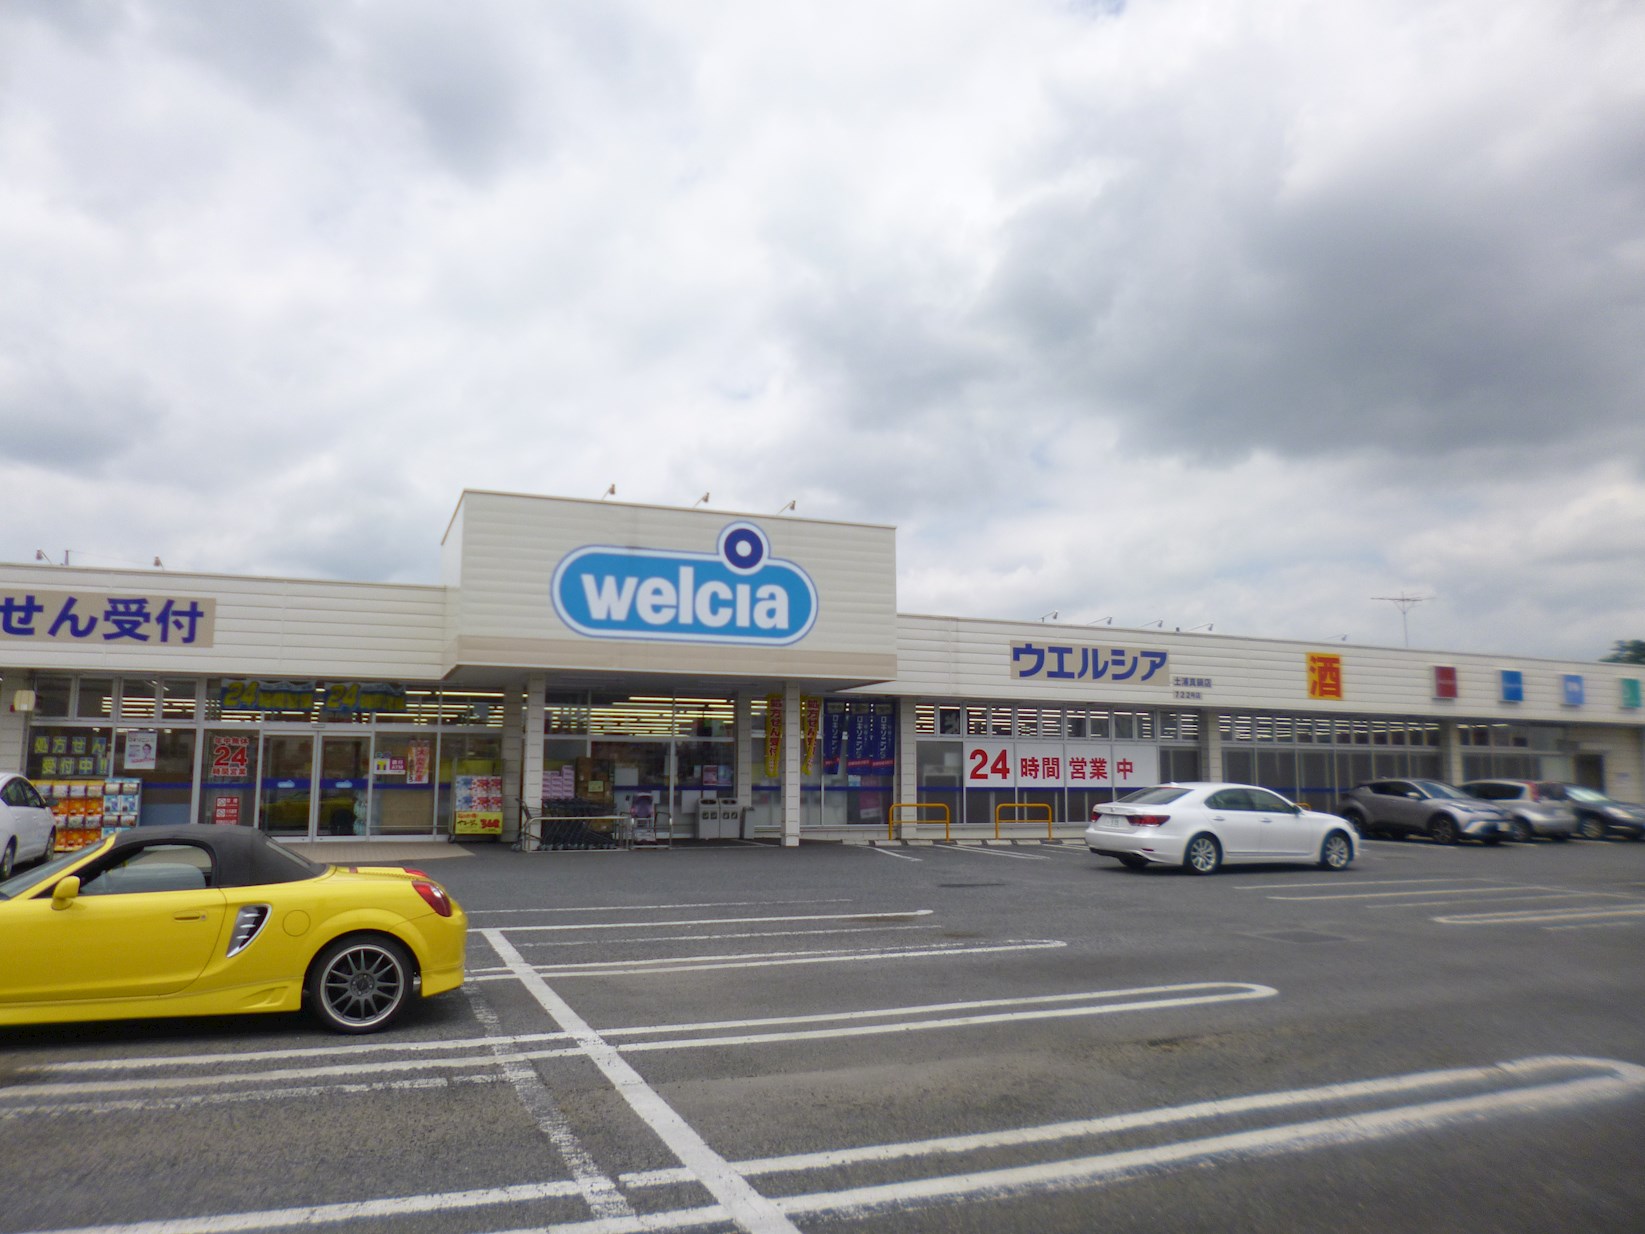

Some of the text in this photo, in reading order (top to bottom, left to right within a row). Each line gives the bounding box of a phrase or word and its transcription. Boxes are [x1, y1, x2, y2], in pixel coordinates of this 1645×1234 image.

[581, 566, 789, 630] welcia
[0, 595, 204, 643] せん受付
[1012, 643, 1168, 681] ウエルシア
[1310, 656, 1341, 697] 酒
[214, 745, 247, 766] 24
